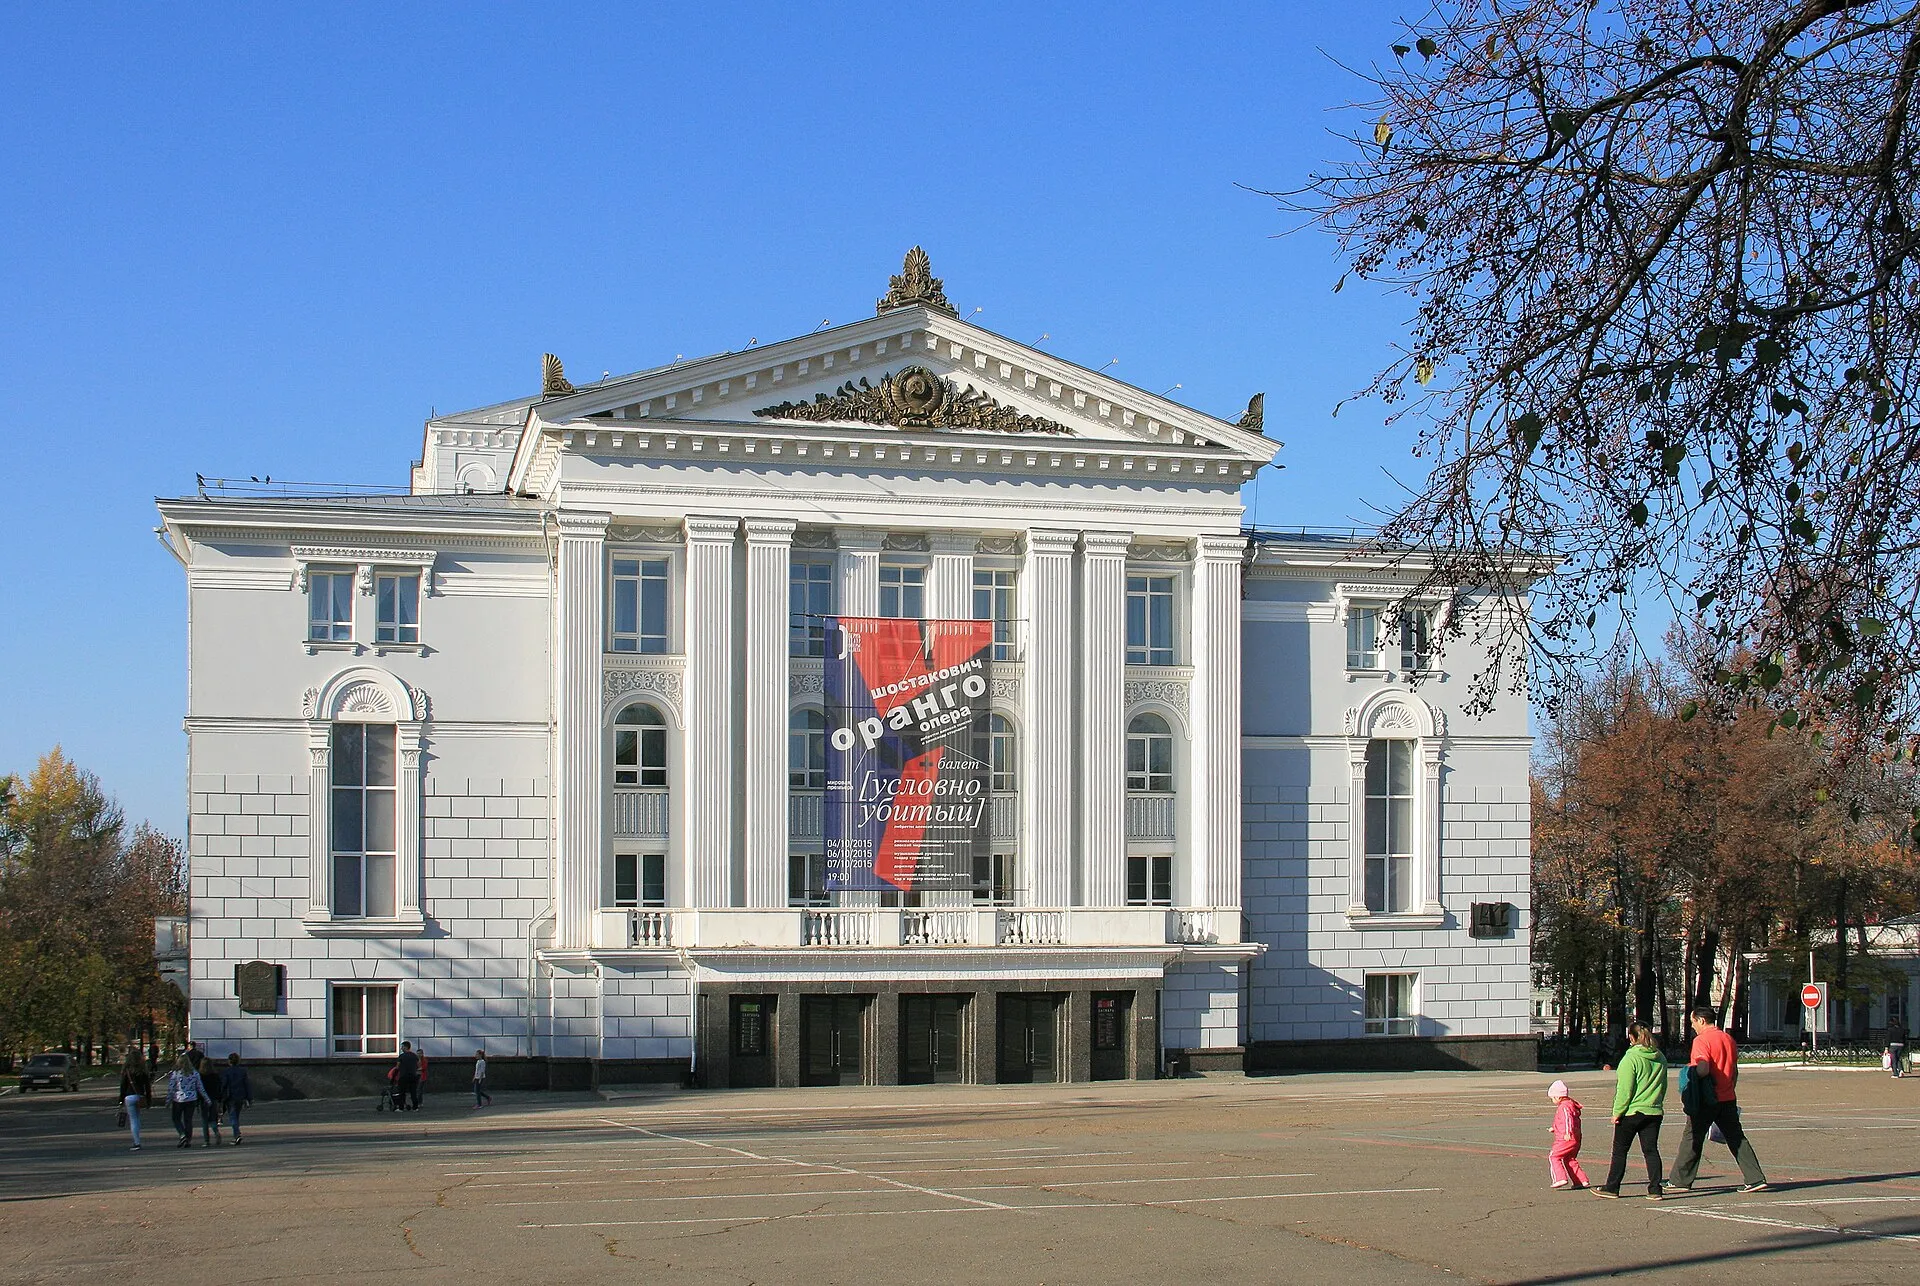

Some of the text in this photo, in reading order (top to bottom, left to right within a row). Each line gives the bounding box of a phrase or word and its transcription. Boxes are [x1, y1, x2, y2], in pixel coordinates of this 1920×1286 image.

[870, 658, 983, 700] шостакович
[831, 675, 986, 751] оранго
[919, 705, 972, 732] опера
[937, 756, 980, 770] балет
[858, 770, 981, 802] [условно
[858, 797, 986, 828] убитый]
[827, 839, 873, 848] 04/10/2015
[827, 849, 873, 858] 06/10/2015
[827, 859, 873, 868] 07/10/2015
[827, 872, 850, 881] 19:00
